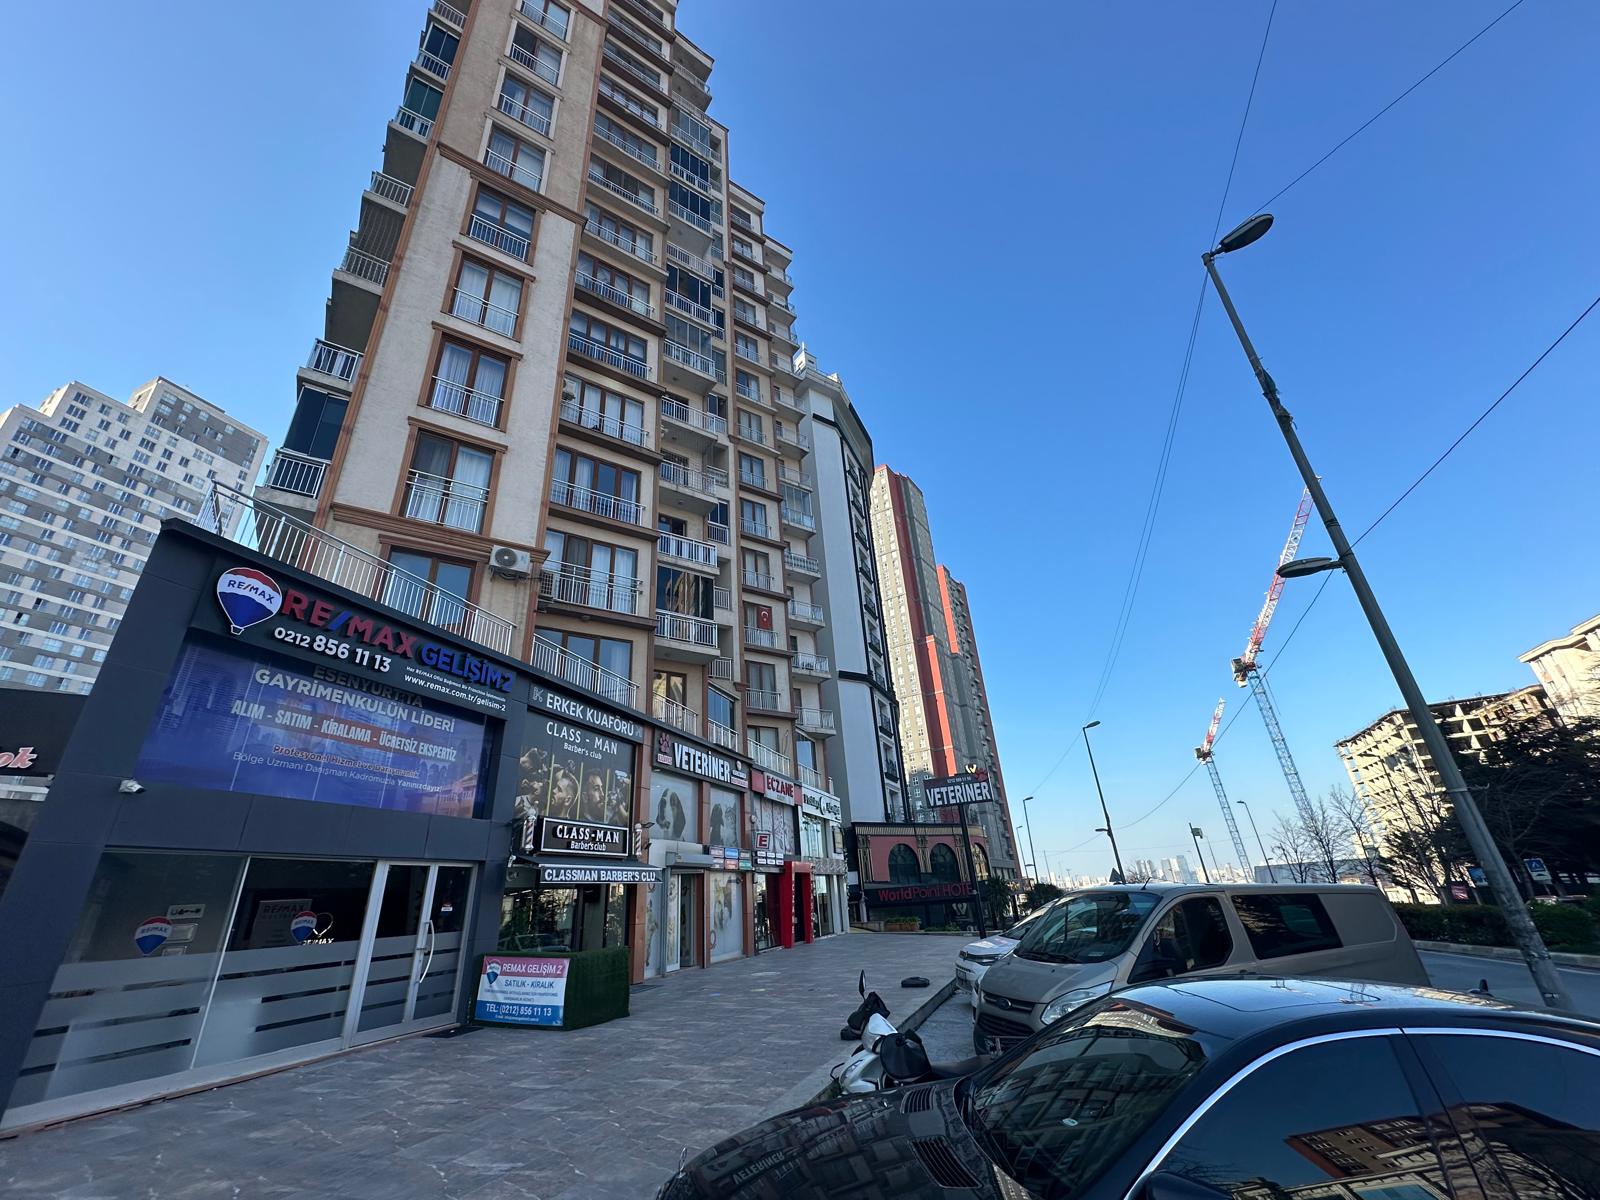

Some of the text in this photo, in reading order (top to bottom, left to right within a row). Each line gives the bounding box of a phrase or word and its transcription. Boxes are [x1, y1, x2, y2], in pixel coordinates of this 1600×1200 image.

[227, 579, 275, 604] RE/MAX
[281, 588, 417, 658] RE/MAX
[274, 627, 392, 673] 0212 856 11 13
[255, 669, 456, 733] GAYRİMENKULÜN LİDERİ
[404, 674, 506, 712] www.remax.com.tr/gelisim-2
[231, 700, 265, 720] ALIM
[274, 709, 313, 730] SATIM
[320, 718, 372, 743] KİRALAMA
[379, 731, 417, 753] ÜCRETSİZ
[546, 693, 634, 736] ERKEK KUAFÖRÜ
[546, 721, 581, 743] CLASS
[594, 737, 618, 755] MAN
[233, 752, 264, 765] Bölge
[267, 758, 303, 770] Uzmanı
[564, 742, 602, 760] Barber's club
[674, 742, 731, 783] VETERİNER
[766, 775, 794, 798] ECZANE
[926, 782, 991, 806] VETERİNER
[556, 825, 620, 844] CLASS-MAN
[759, 836, 768, 847] E
[545, 869, 597, 881] CLASSMAN
[600, 870, 640, 881] BARBER'S
[502, 963, 527, 973] REMAX
[527, 962, 556, 975] GELİŞİM
[557, 965, 563, 974] 2
[504, 980, 526, 988] SATILIK
[530, 979, 554, 989] KİRALIK
[500, 1005, 519, 1016] (0212)
[520, 1006, 532, 1015] 856
[543, 1008, 552, 1016] 13
